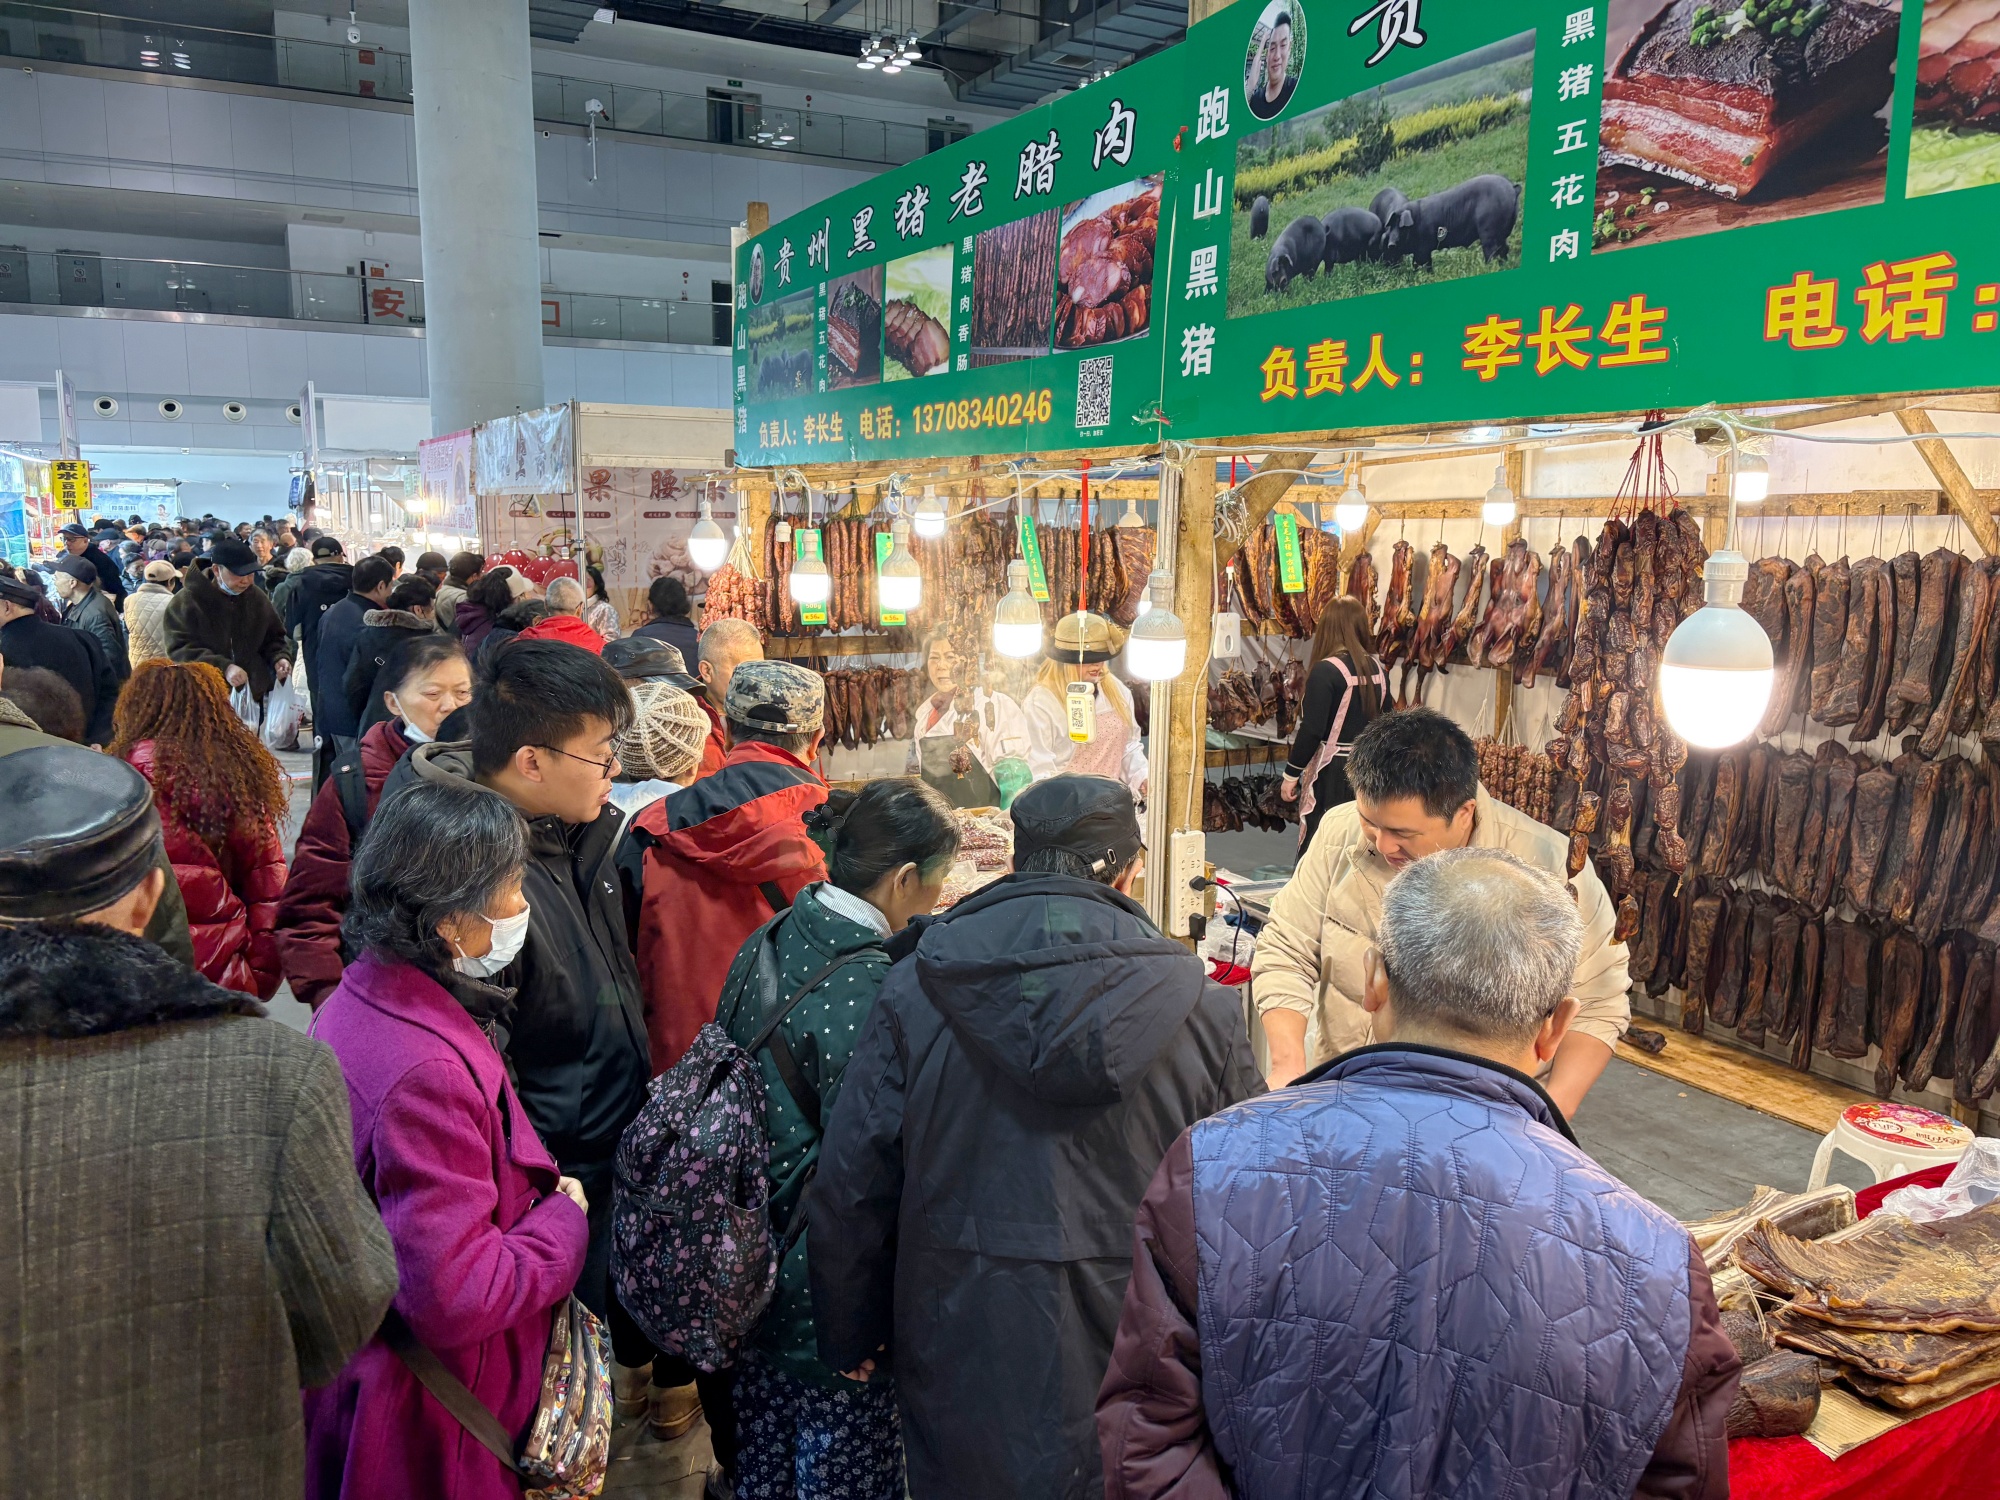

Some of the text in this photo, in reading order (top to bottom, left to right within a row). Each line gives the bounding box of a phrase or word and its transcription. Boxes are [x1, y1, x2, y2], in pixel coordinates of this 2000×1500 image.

[772, 98, 1138, 290] 贵州黑猪老腊肉
[1547, 6, 1597, 264] 黑猪五花肉
[372, 286, 406, 319] 安
[955, 235, 975, 373] 黑猪肉香肠
[1179, 85, 1231, 378] 跑山黑猪
[736, 281, 748, 436] 跑山黑猪
[818, 282, 828, 394] 黑猪五花肉
[1259, 250, 2000, 403] 负责人：李长生 电话：
[56, 461, 79, 508] 赶水豆腐乳
[583, 468, 613, 503] 果
